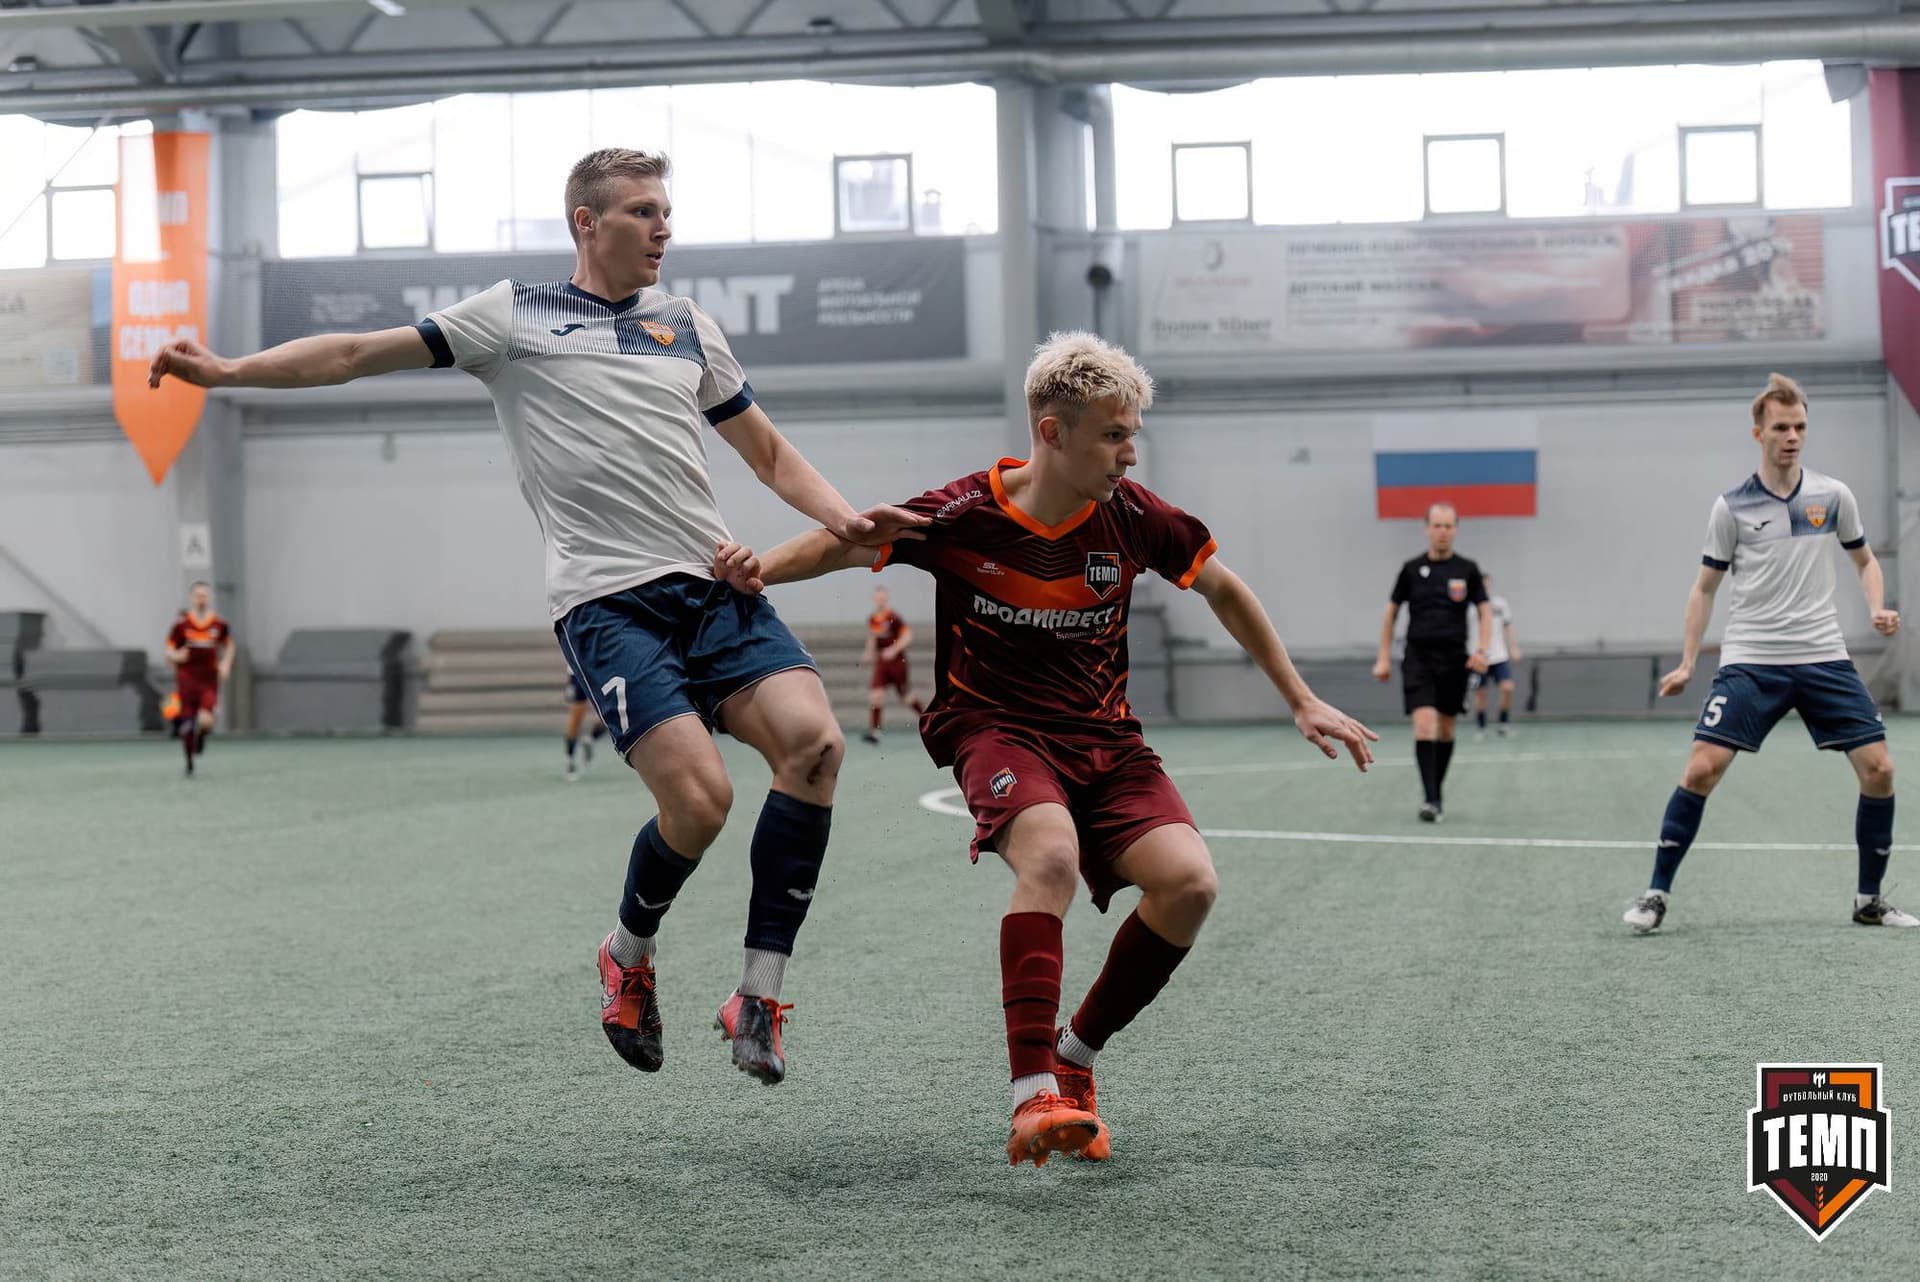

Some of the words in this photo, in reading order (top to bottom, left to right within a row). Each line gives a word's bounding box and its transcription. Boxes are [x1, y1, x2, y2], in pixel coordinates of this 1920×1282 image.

[1890, 210, 1920, 255] ТЕ
[1089, 566, 1118, 583] ТЕМП
[973, 594, 1115, 630] ПРОДИНВЕСТ
[1704, 695, 1728, 727] 5
